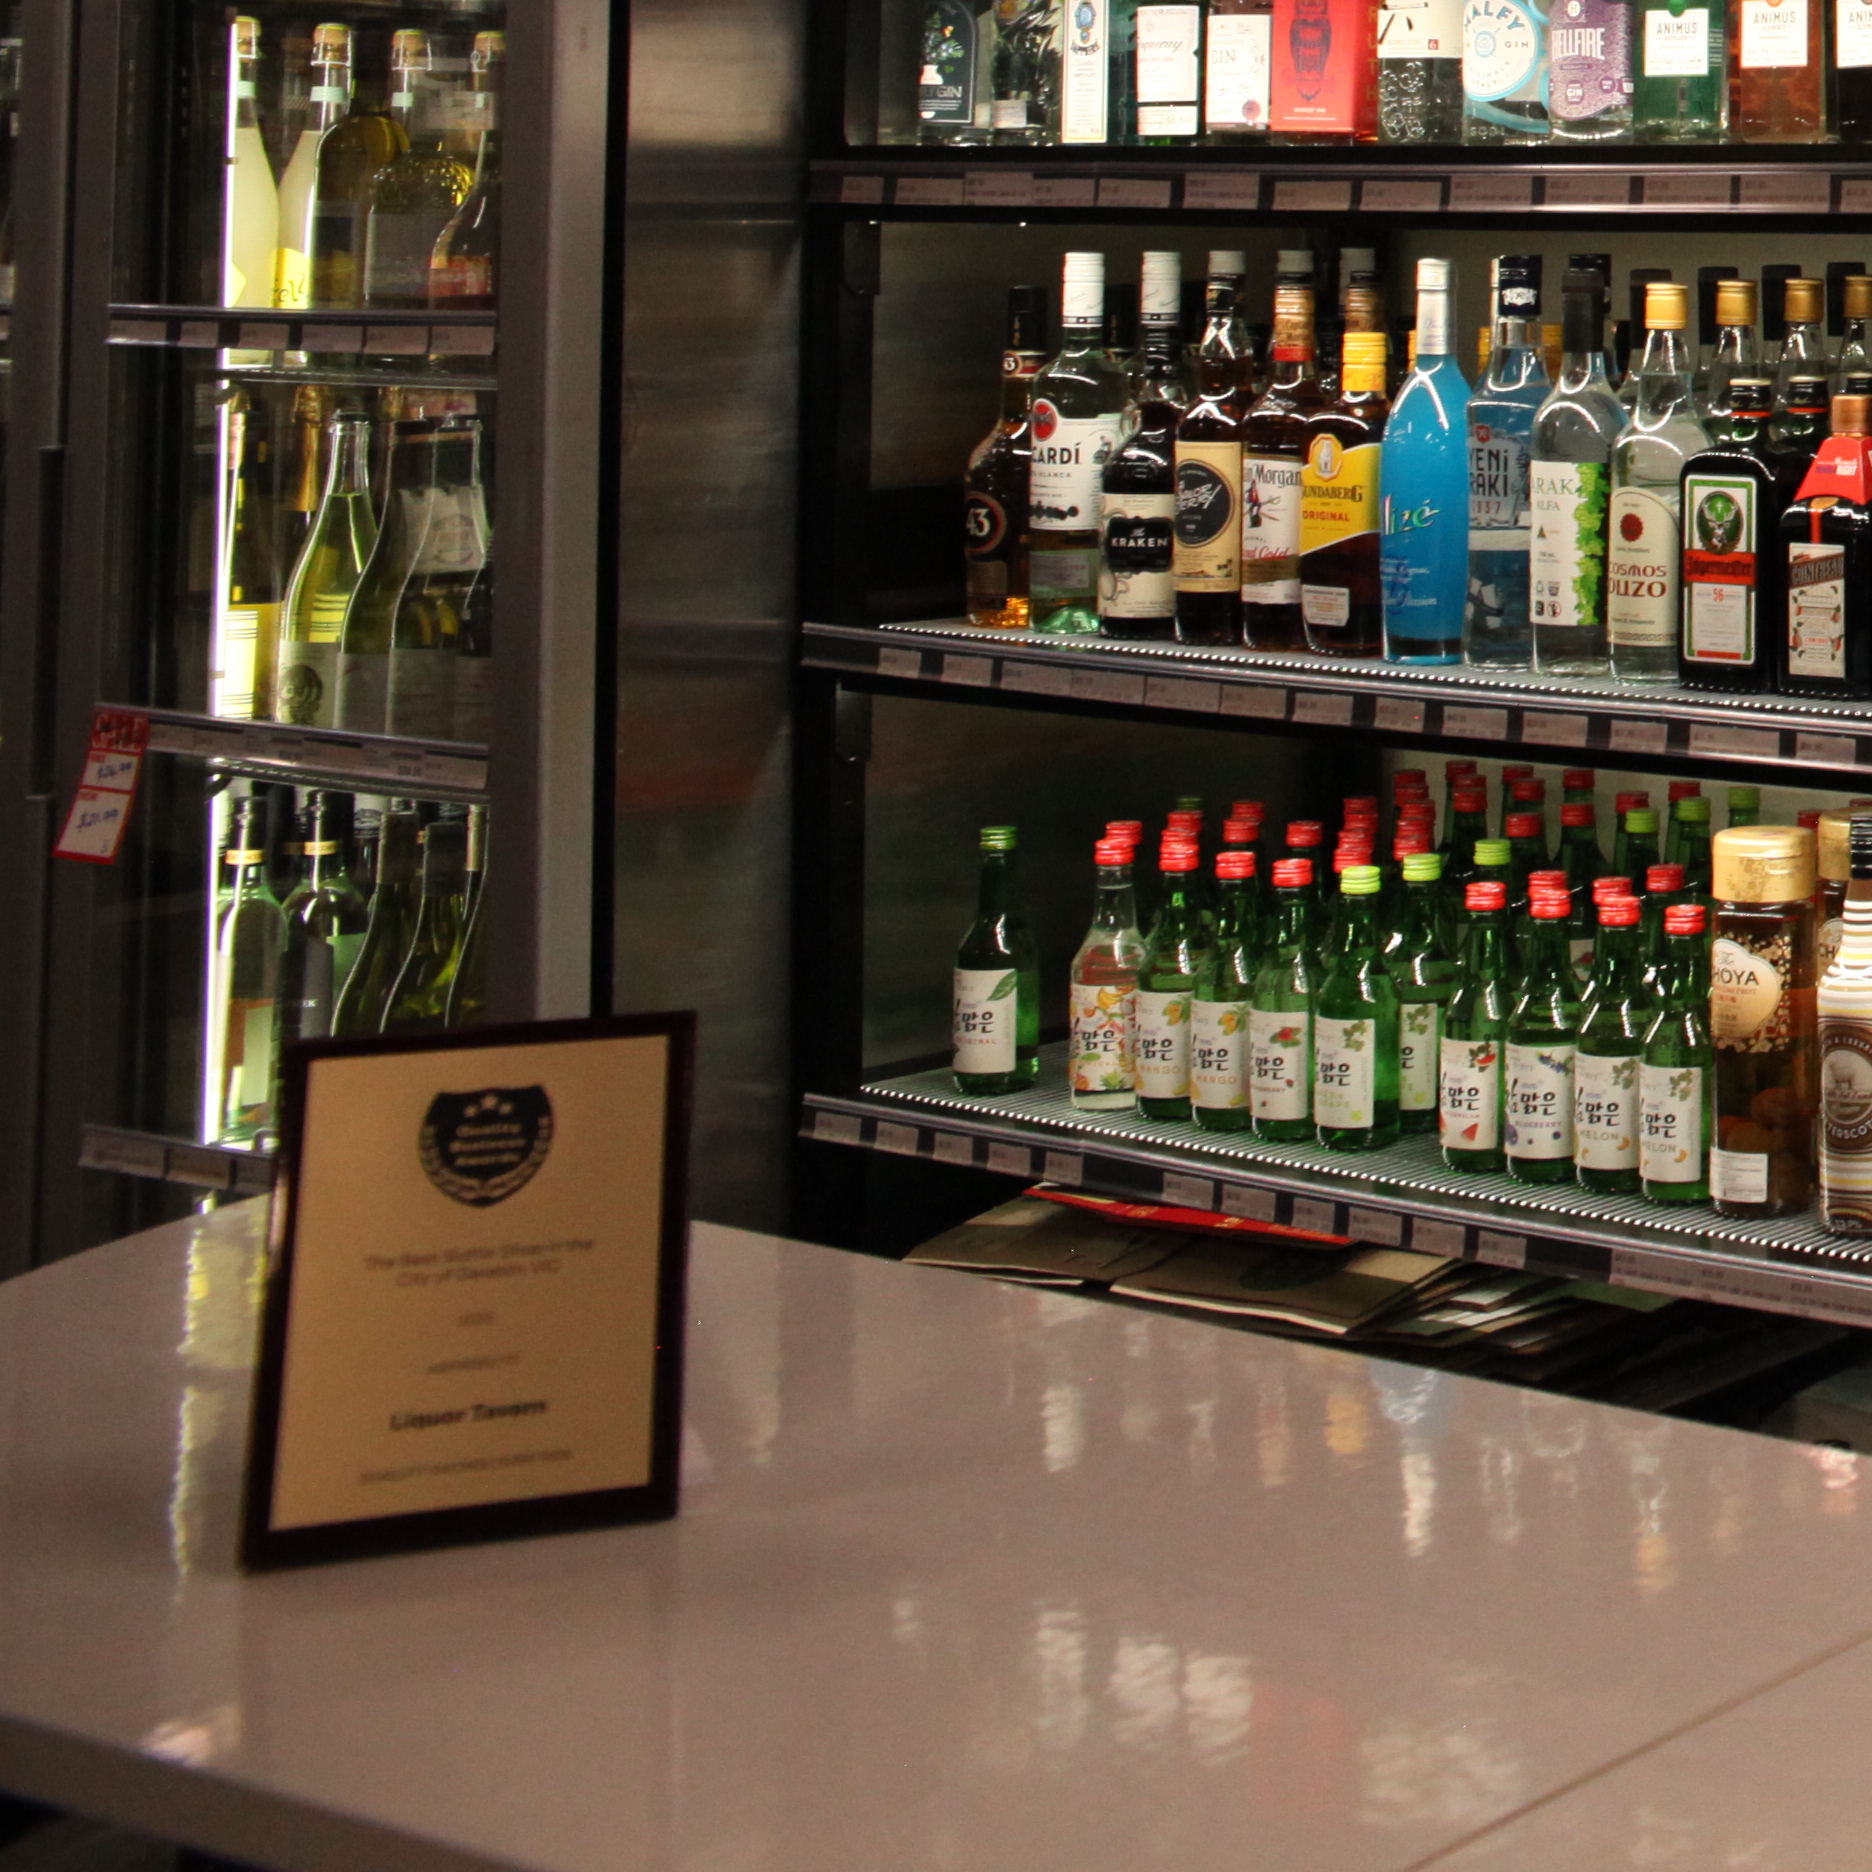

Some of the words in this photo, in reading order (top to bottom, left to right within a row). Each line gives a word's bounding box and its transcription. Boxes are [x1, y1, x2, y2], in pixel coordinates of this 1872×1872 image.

[1754, 11, 1796, 24] ANIMUS
[1656, 22, 1697, 35] ANIMUS
[1111, 536, 1167, 548] KRAKEN
